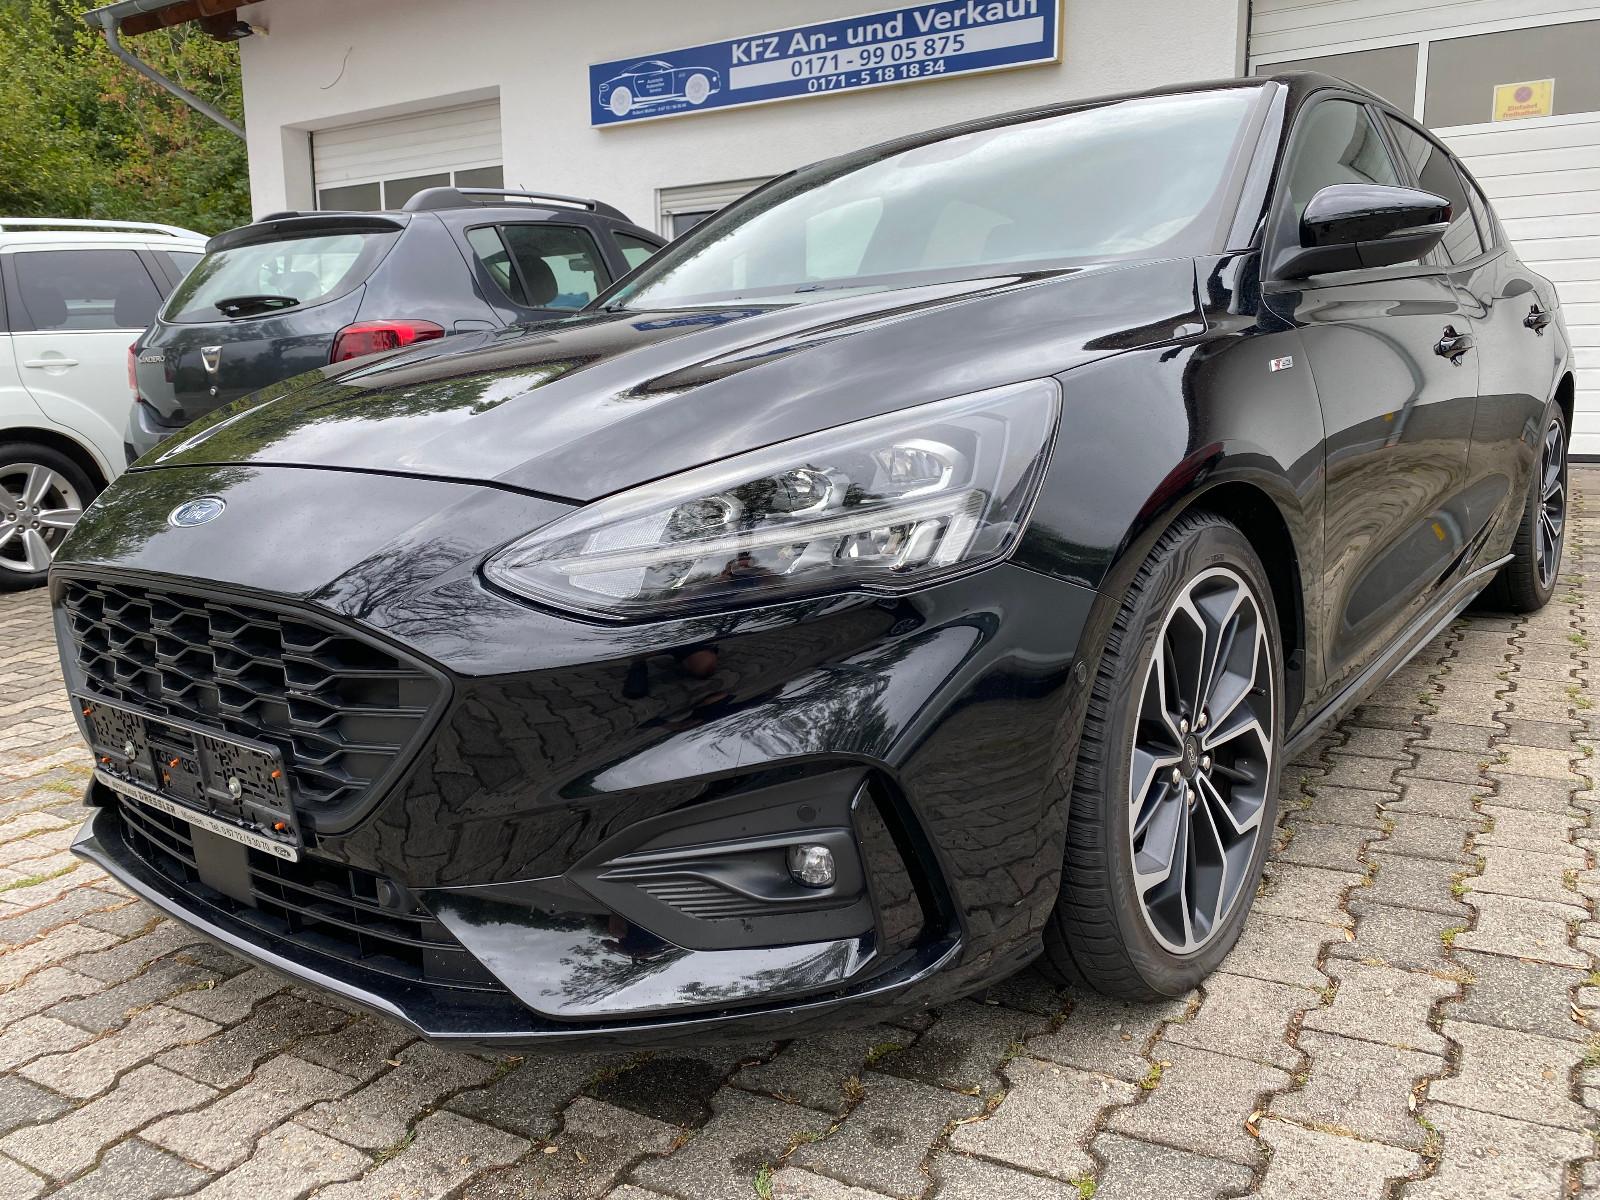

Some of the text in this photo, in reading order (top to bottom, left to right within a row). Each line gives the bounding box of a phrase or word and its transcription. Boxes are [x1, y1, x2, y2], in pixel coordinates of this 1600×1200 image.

[731, 36, 779, 64] KFZ
[787, 32, 837, 55] An-
[846, 13, 903, 44] und
[791, 53, 839, 77] 0171
[860, 46, 885, 67] 99
[891, 41, 917, 62] 05
[923, 33, 965, 56] 875
[807, 74, 846, 92] 0171
[860, 71, 871, 84] 5
[875, 67, 895, 82] 18
[900, 63, 920, 78] 18
[924, 59, 946, 75] 34
